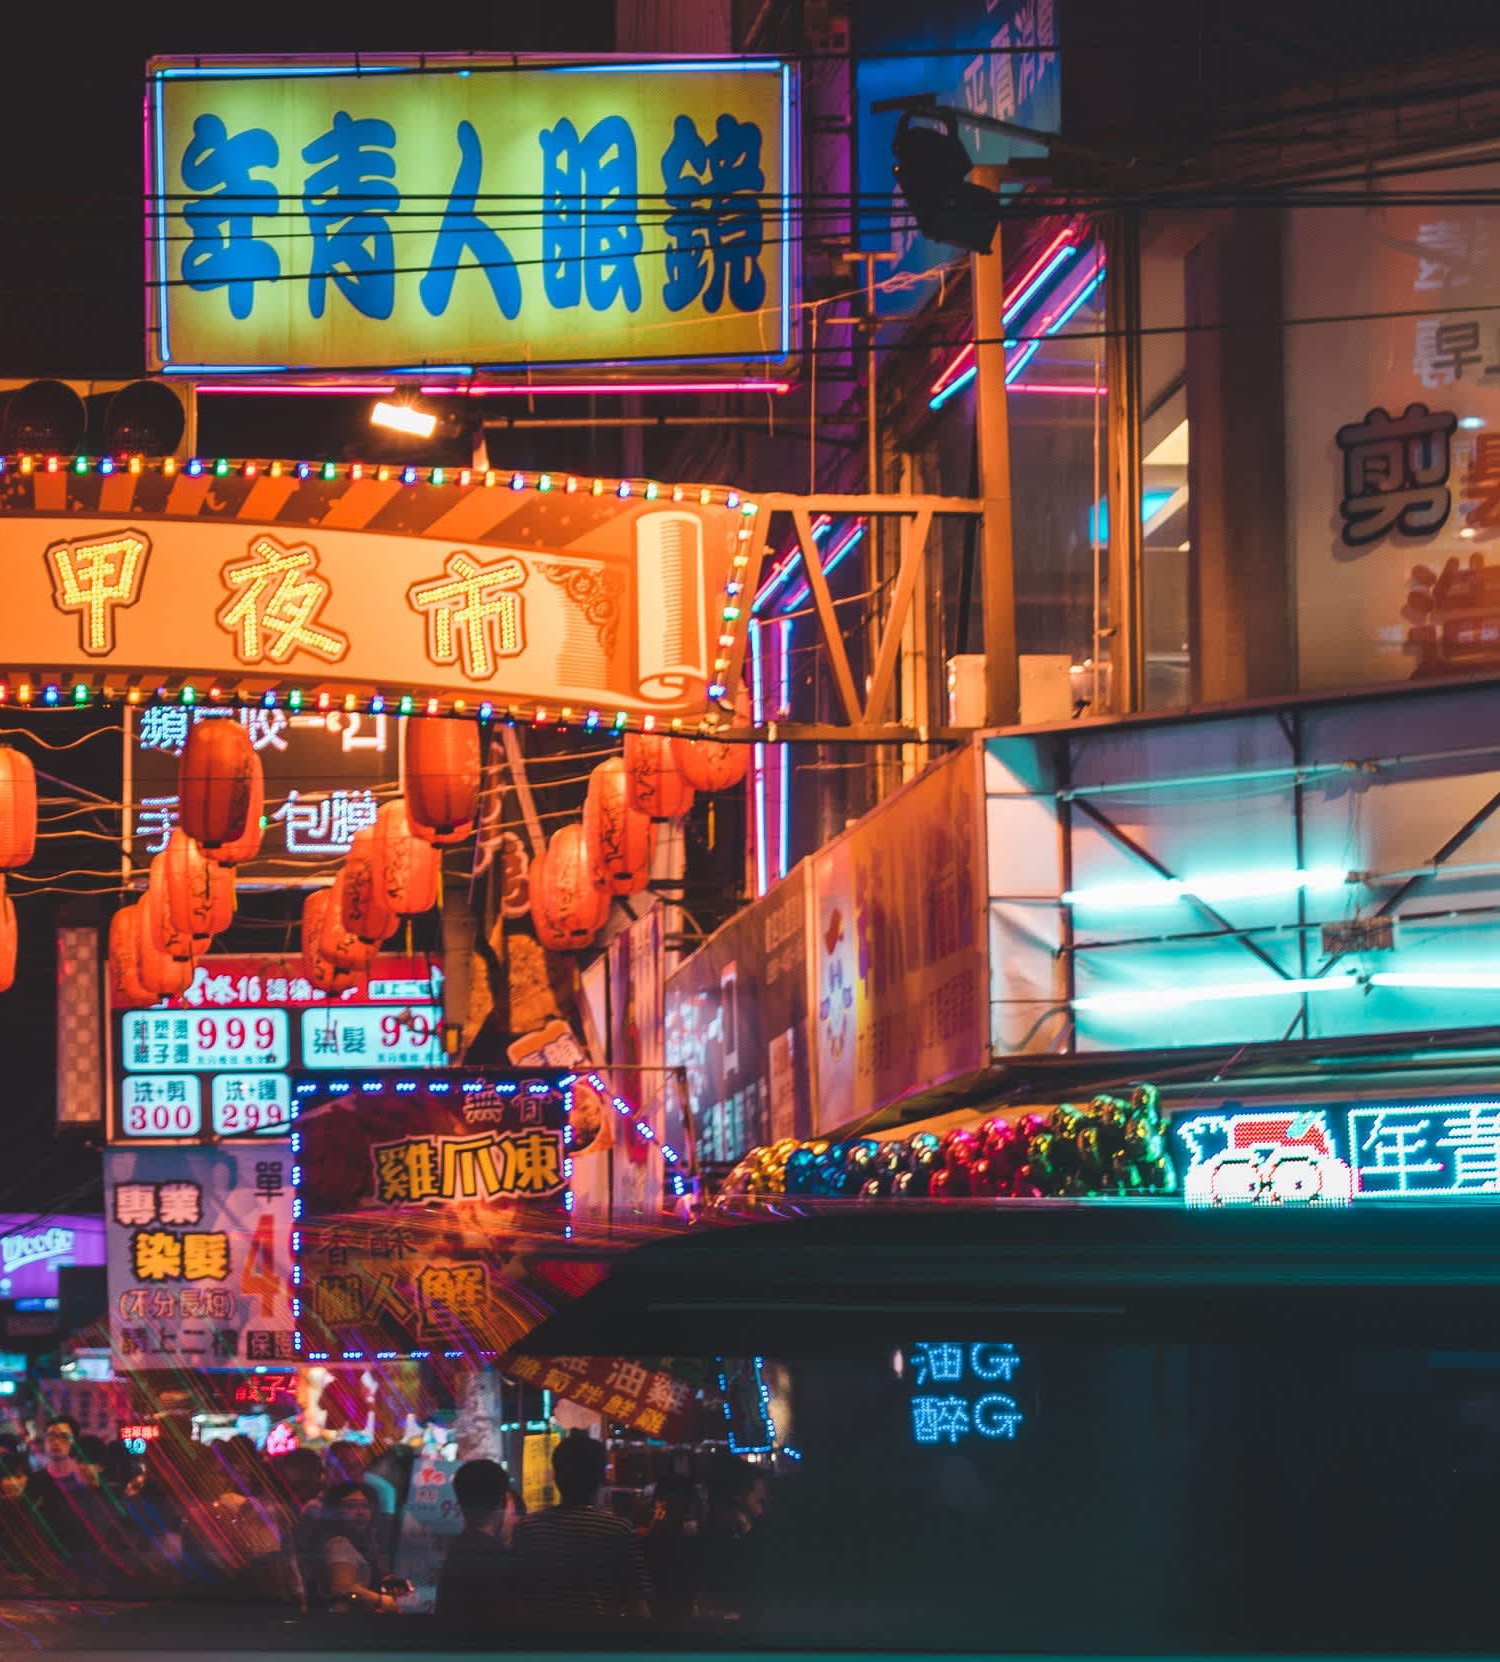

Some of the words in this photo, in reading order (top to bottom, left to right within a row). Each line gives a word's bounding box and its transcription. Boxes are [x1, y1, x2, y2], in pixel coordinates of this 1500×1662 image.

[180, 111, 766, 321] 年青人眼鏡
[197, 1017, 275, 1050] 999
[130, 1104, 193, 1131] 300
[221, 1104, 285, 1130] 299
[376, 1132, 562, 1202] 雞爪凍
[131, 1231, 229, 1281] 染髮
